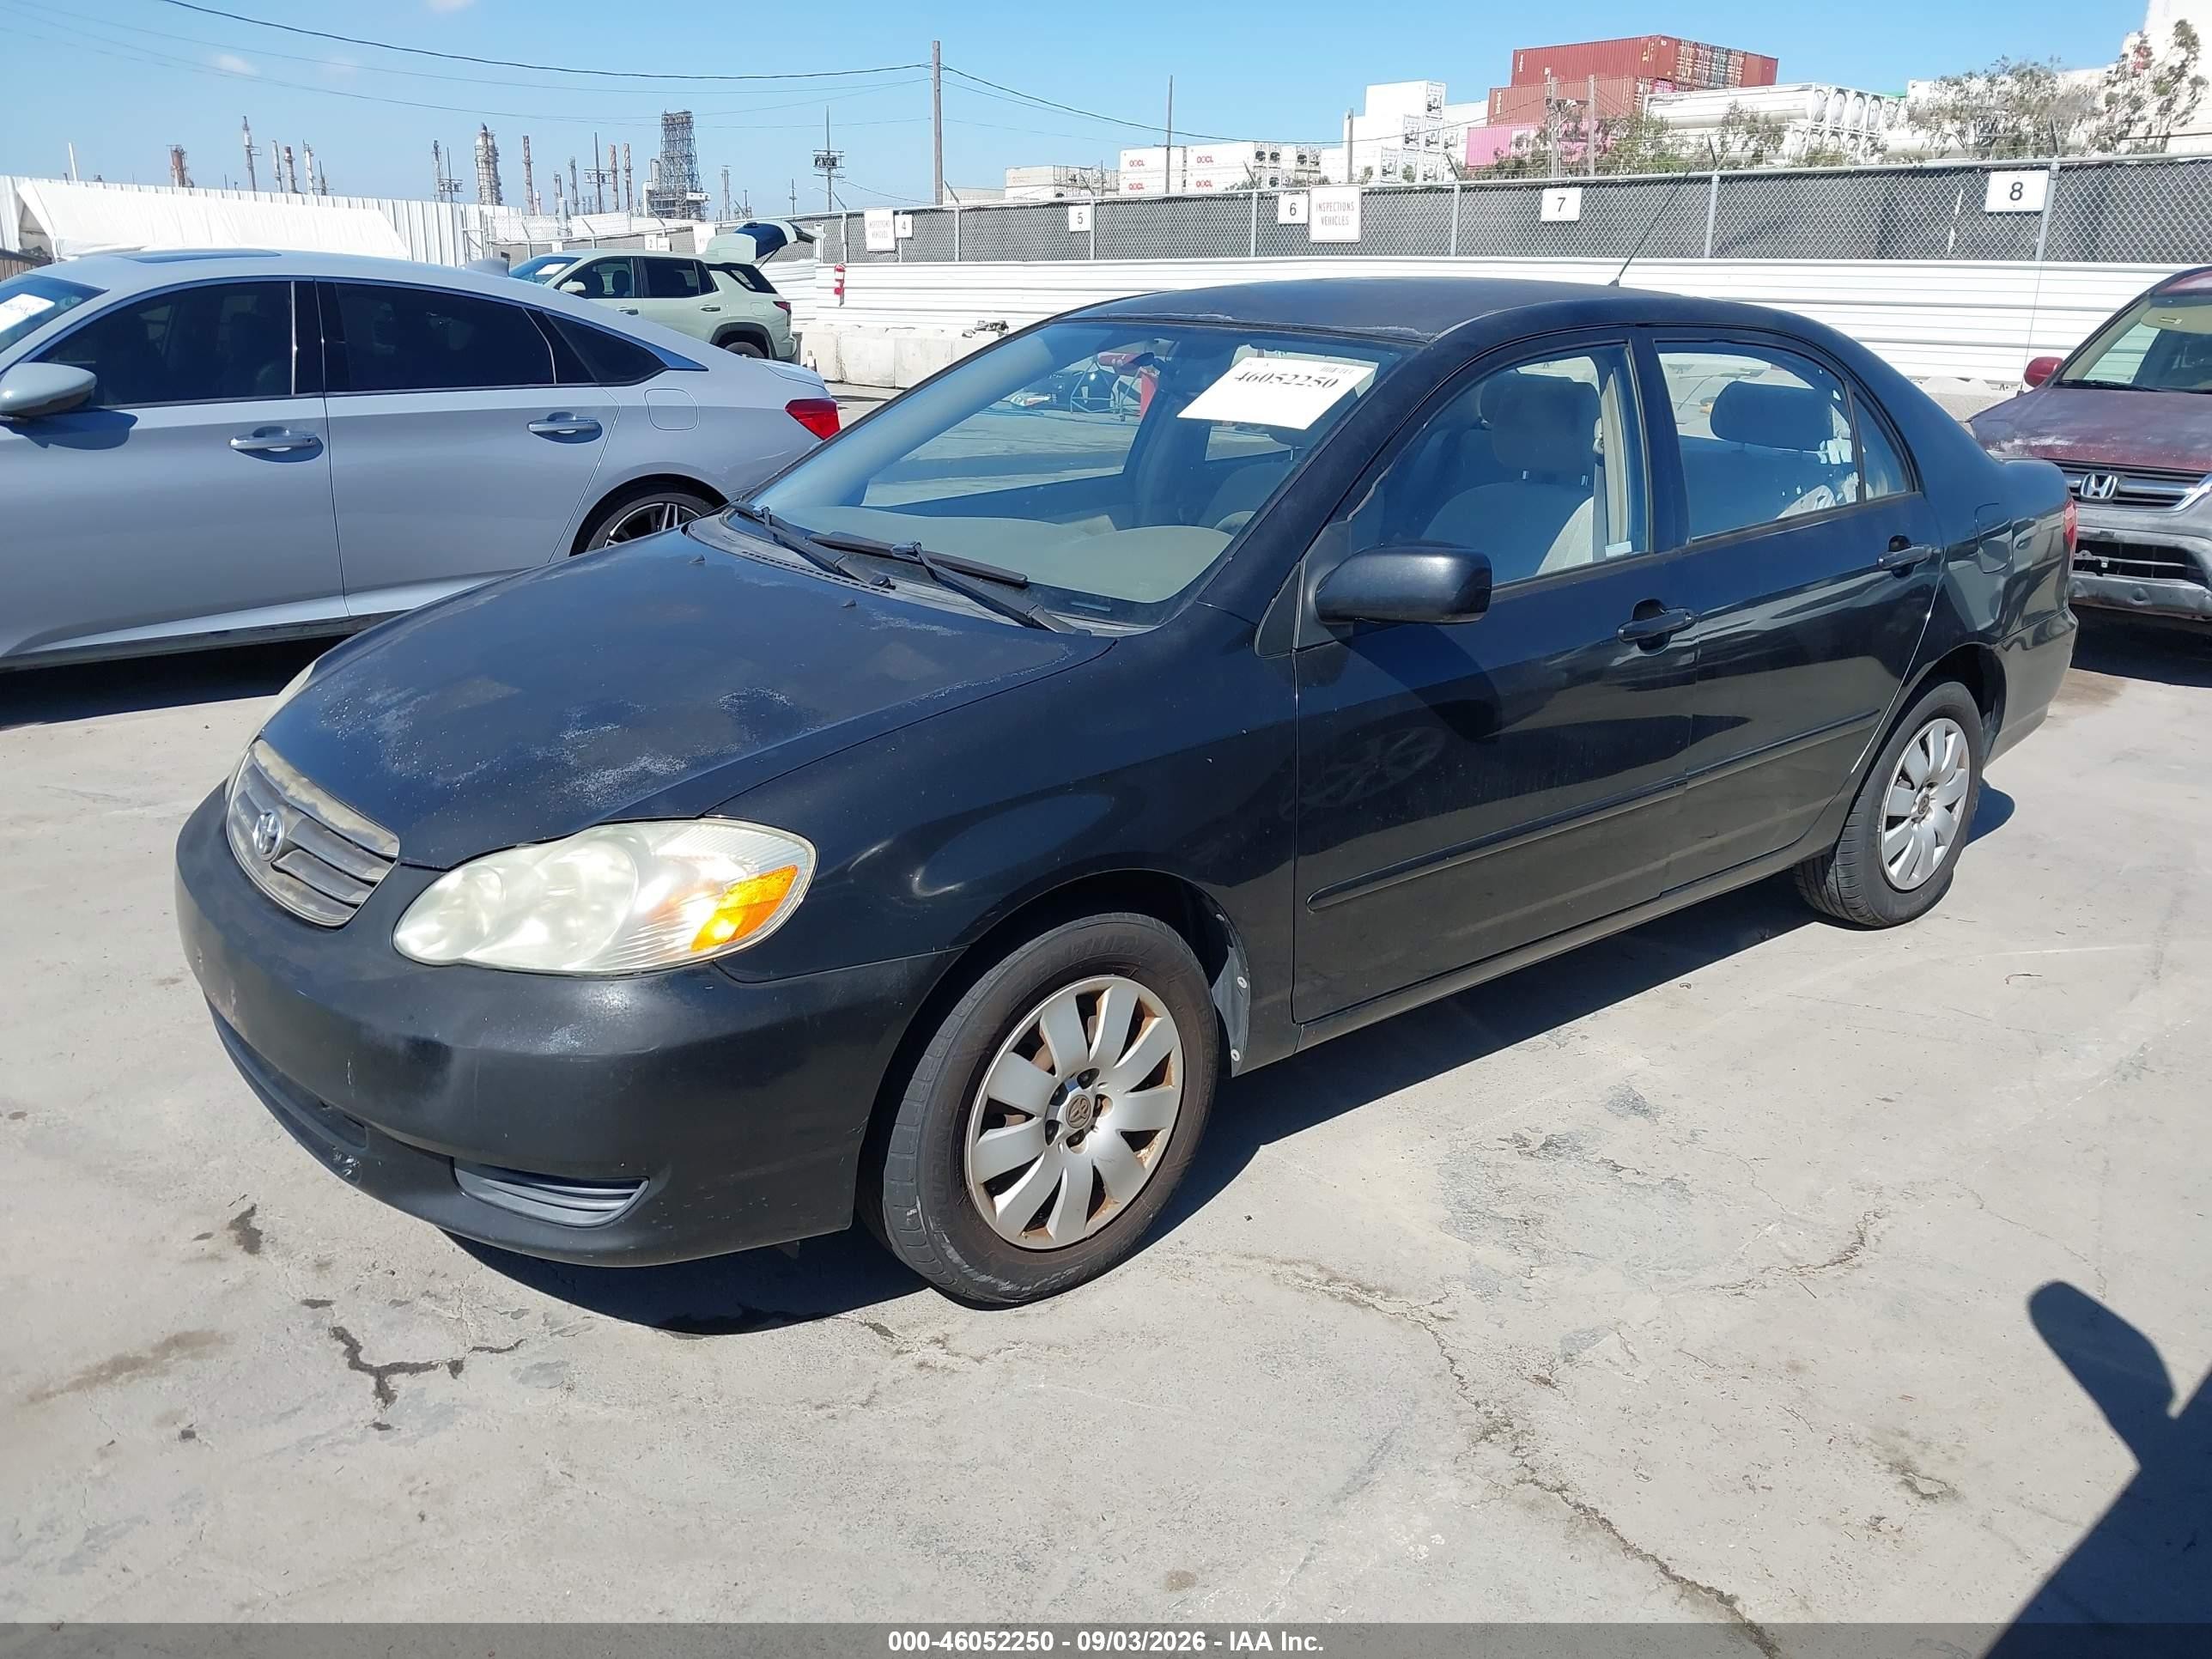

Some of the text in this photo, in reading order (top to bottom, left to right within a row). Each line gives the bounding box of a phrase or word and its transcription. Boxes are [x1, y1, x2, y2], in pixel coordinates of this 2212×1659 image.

[2009, 181, 2023, 201] 8
[1290, 202, 1297, 216] 6
[1316, 201, 1355, 212] INSPECTIONS
[1557, 197, 1567, 212] 7
[1078, 212, 1084, 224] 5
[1321, 216, 1349, 226] VEHICLES
[901, 220, 907, 230] 4
[648, 239, 653, 249] 2
[1234, 371, 1340, 388] 46052250
